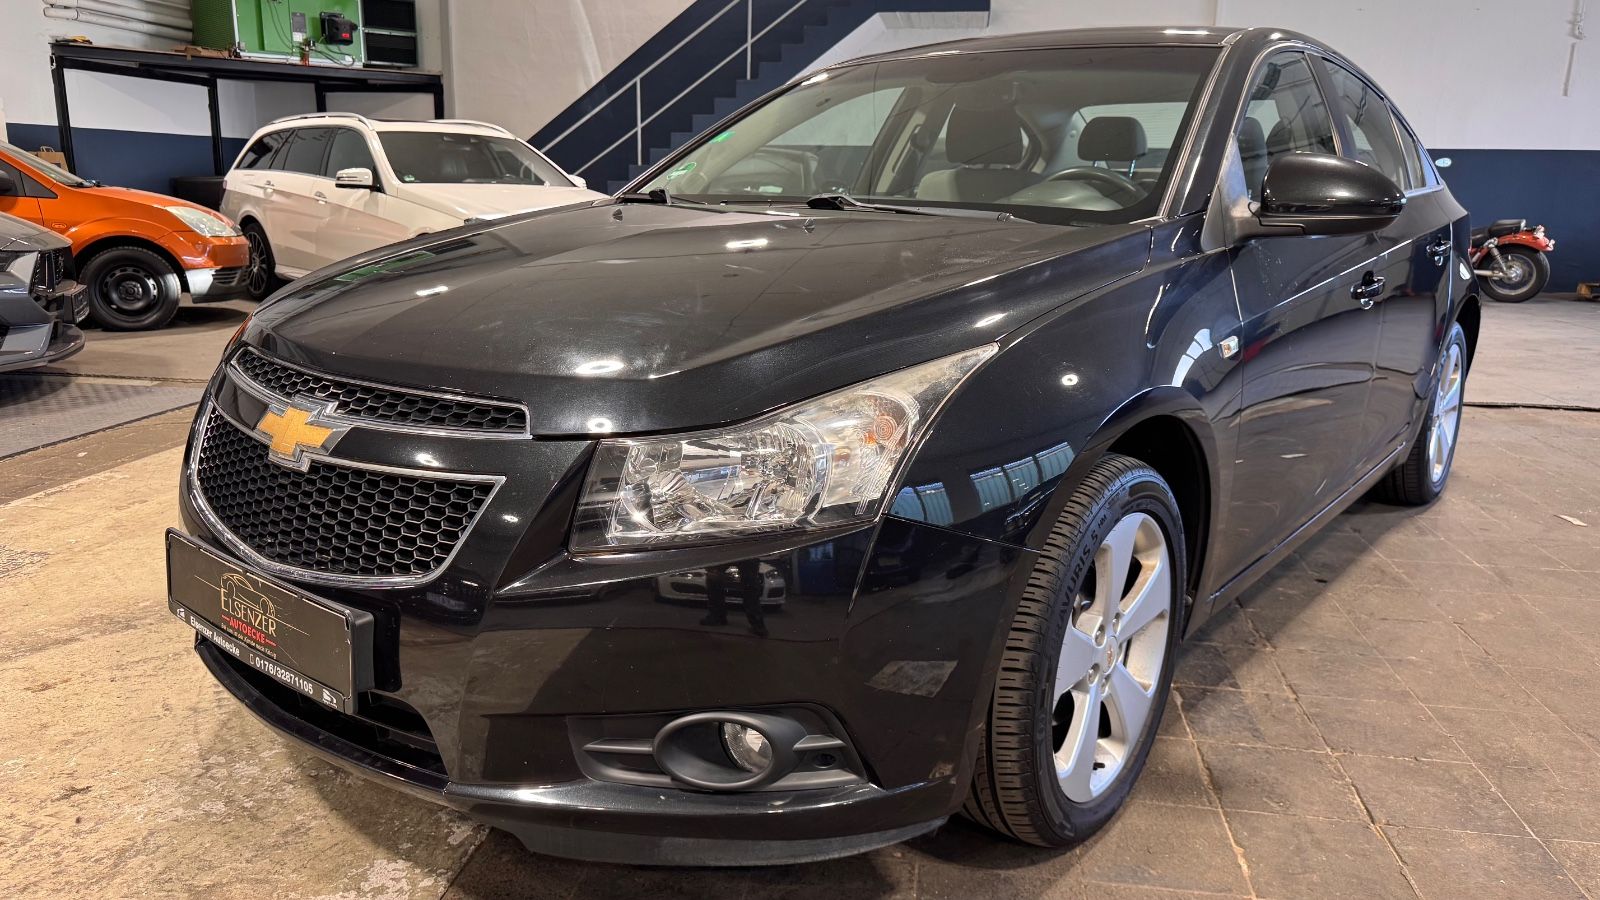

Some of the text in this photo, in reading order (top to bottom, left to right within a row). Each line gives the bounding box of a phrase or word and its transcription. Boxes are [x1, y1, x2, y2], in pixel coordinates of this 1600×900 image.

[221, 588, 276, 637] ELSENZER
[1049, 543, 1092, 646] RAVURIS
[190, 615, 213, 638] Elsenzer
[213, 631, 240, 656] Autoecke
[230, 617, 265, 643] AUTOECKE
[255, 656, 313, 695] 0176/32871105
